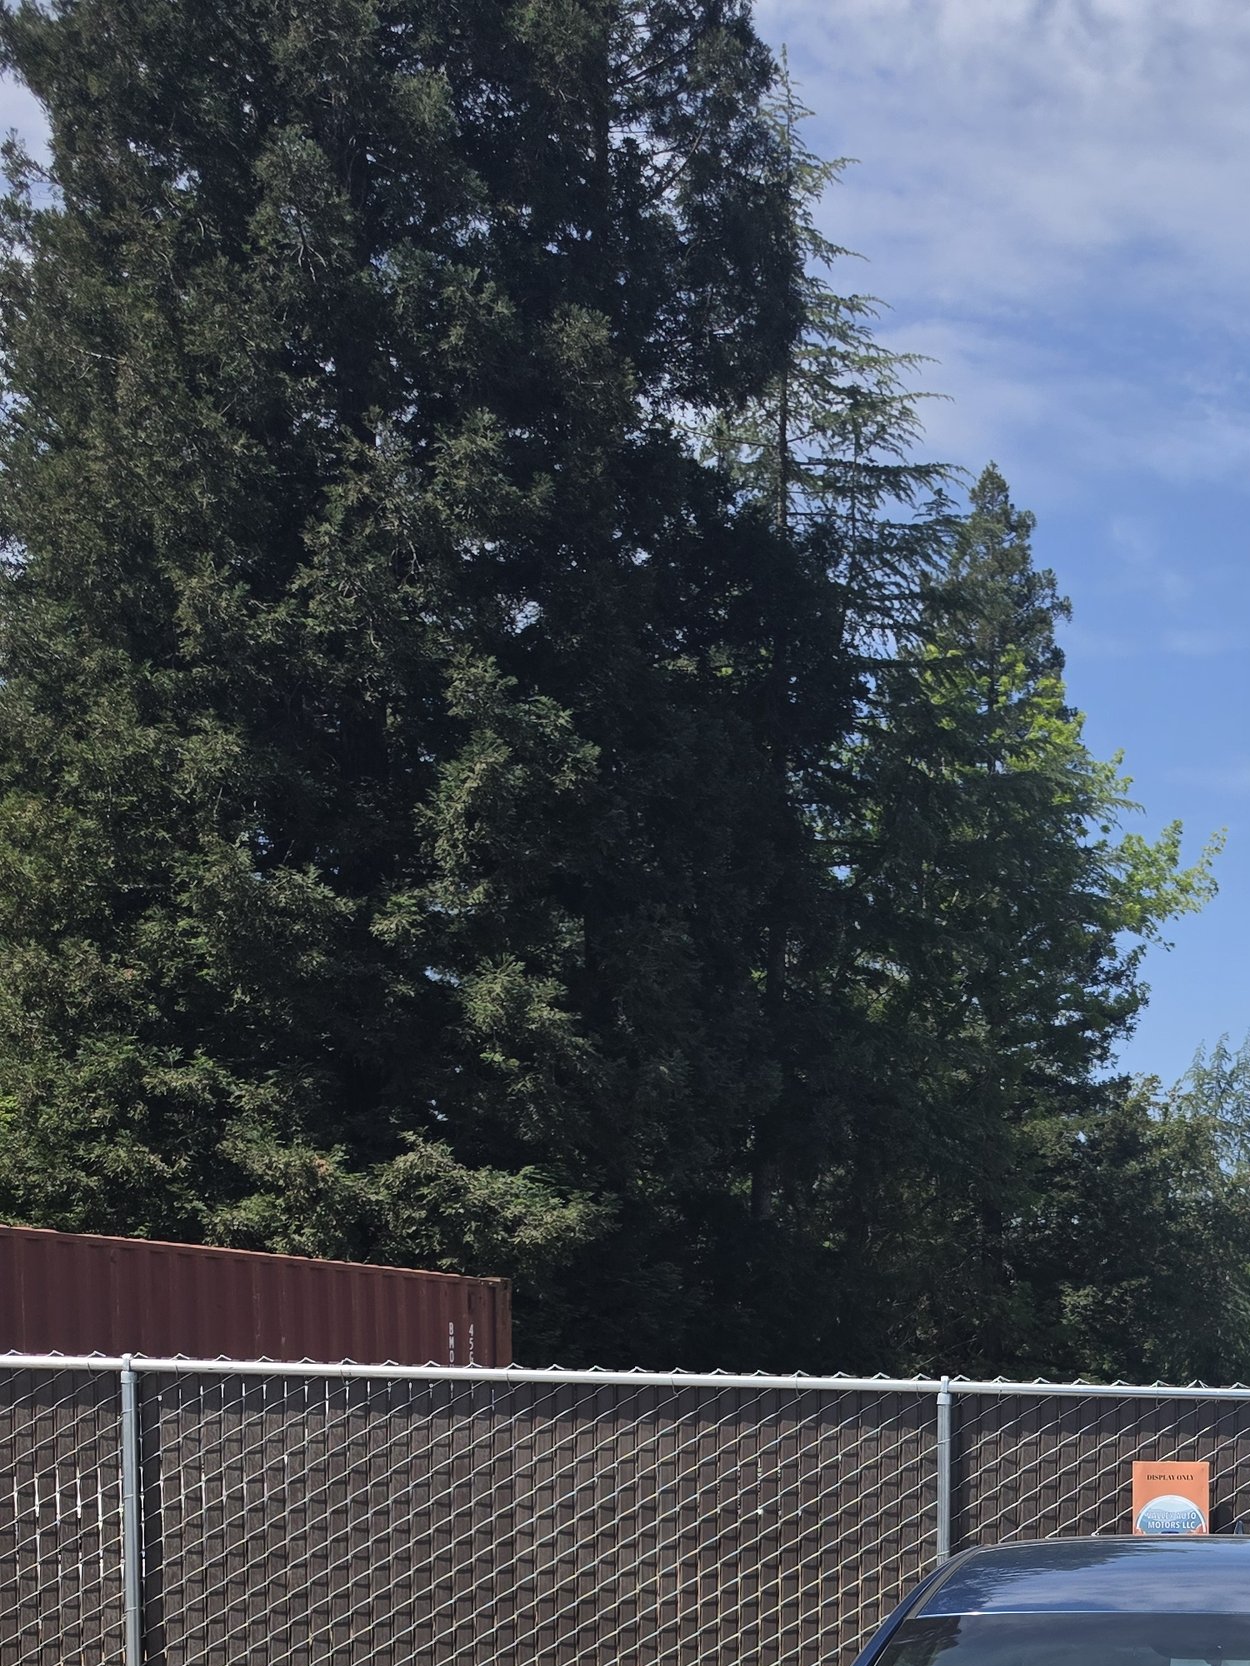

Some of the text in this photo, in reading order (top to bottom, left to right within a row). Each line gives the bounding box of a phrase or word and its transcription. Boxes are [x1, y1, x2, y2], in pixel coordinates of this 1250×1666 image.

[1175, 1511, 1197, 1520] AUTO
[1147, 1521, 1196, 1529] MOTORS LLC
